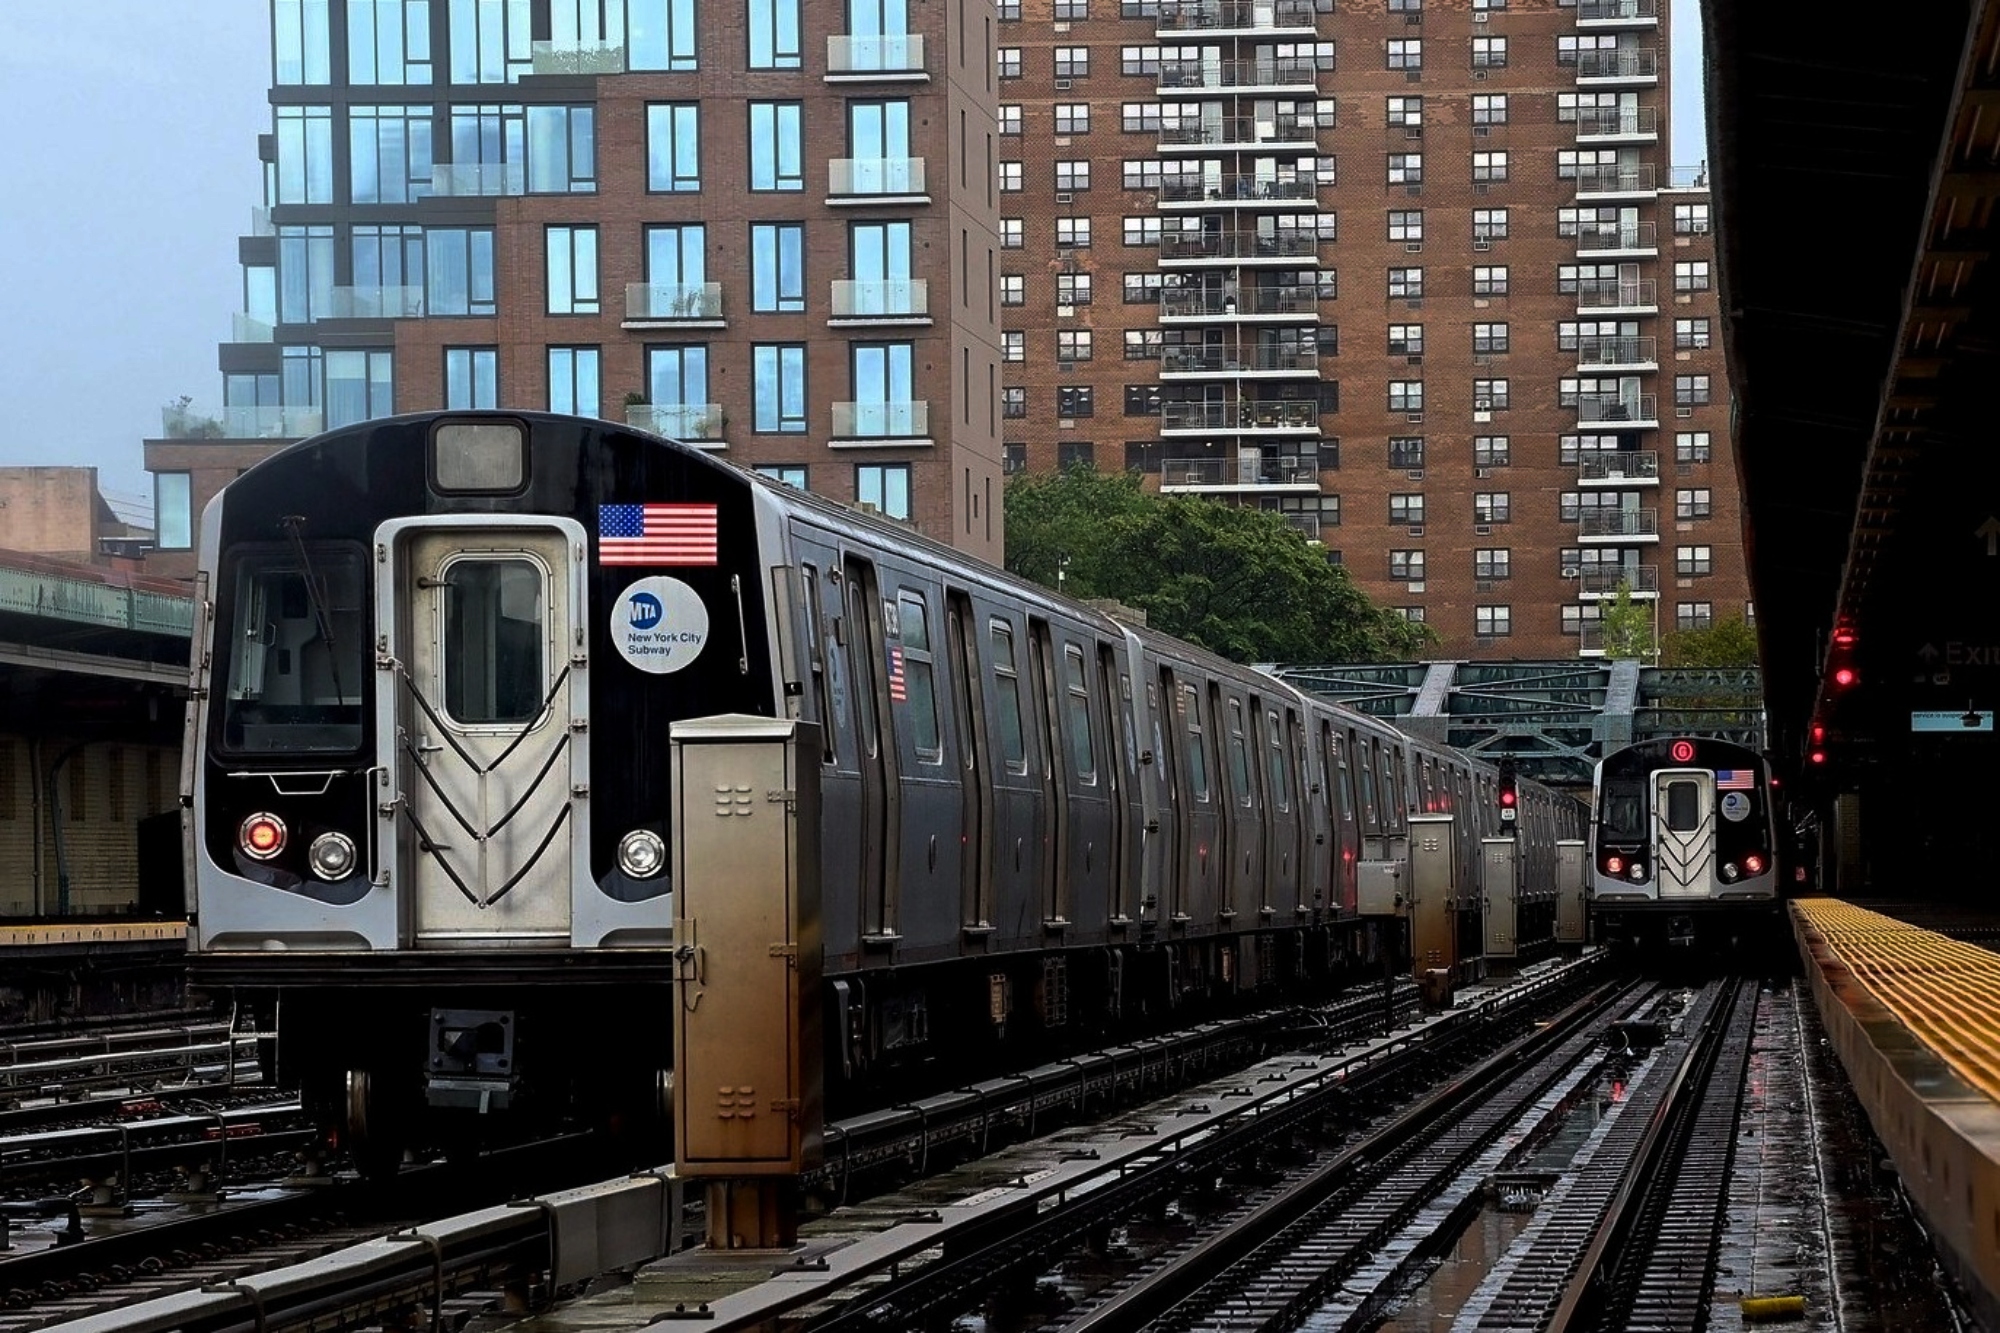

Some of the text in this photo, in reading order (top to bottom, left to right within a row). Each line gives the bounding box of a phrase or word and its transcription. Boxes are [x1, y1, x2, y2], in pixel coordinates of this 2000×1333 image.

[628, 601, 657, 622] MTA
[628, 632, 702, 644] New York City
[628, 645, 671, 656] Subway
